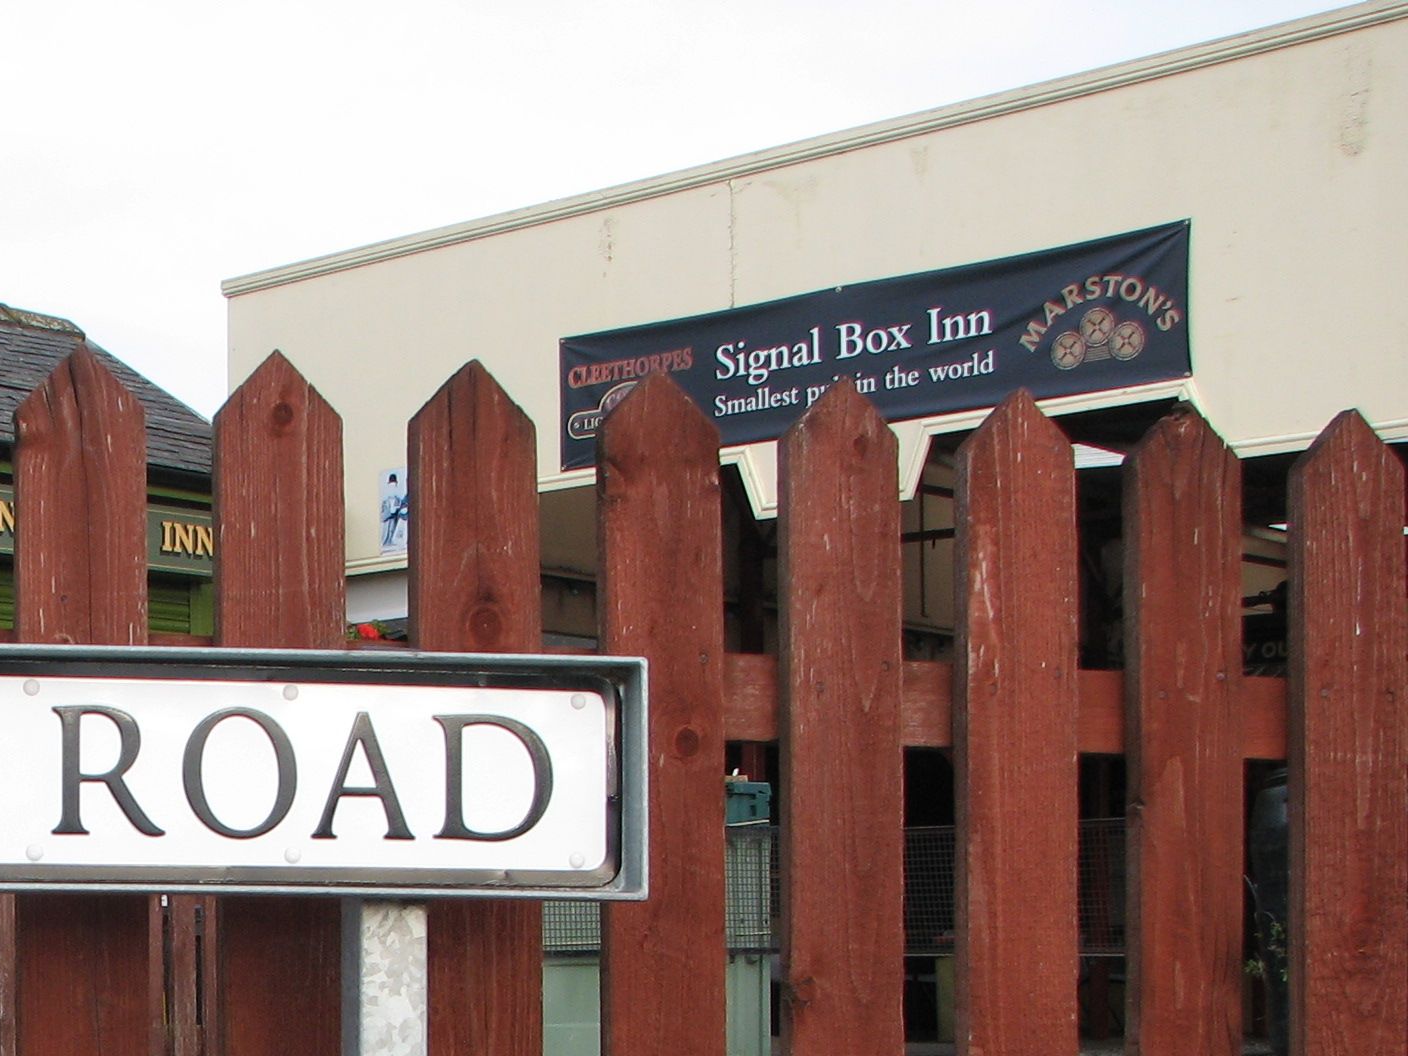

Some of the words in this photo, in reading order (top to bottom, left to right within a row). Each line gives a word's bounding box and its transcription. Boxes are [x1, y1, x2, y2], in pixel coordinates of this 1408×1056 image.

[715, 326, 822, 385] Signal
[835, 321, 912, 360] Box
[926, 307, 993, 345] Inn
[1019, 275, 1181, 352] MARSTON'S
[568, 347, 692, 390] CLEETHORPES
[713, 385, 800, 417] Smallest
[854, 372, 877, 394] in
[885, 365, 919, 390] the
[928, 350, 994, 383] world
[162, 520, 214, 557] INN
[50, 704, 554, 842] ROAD
